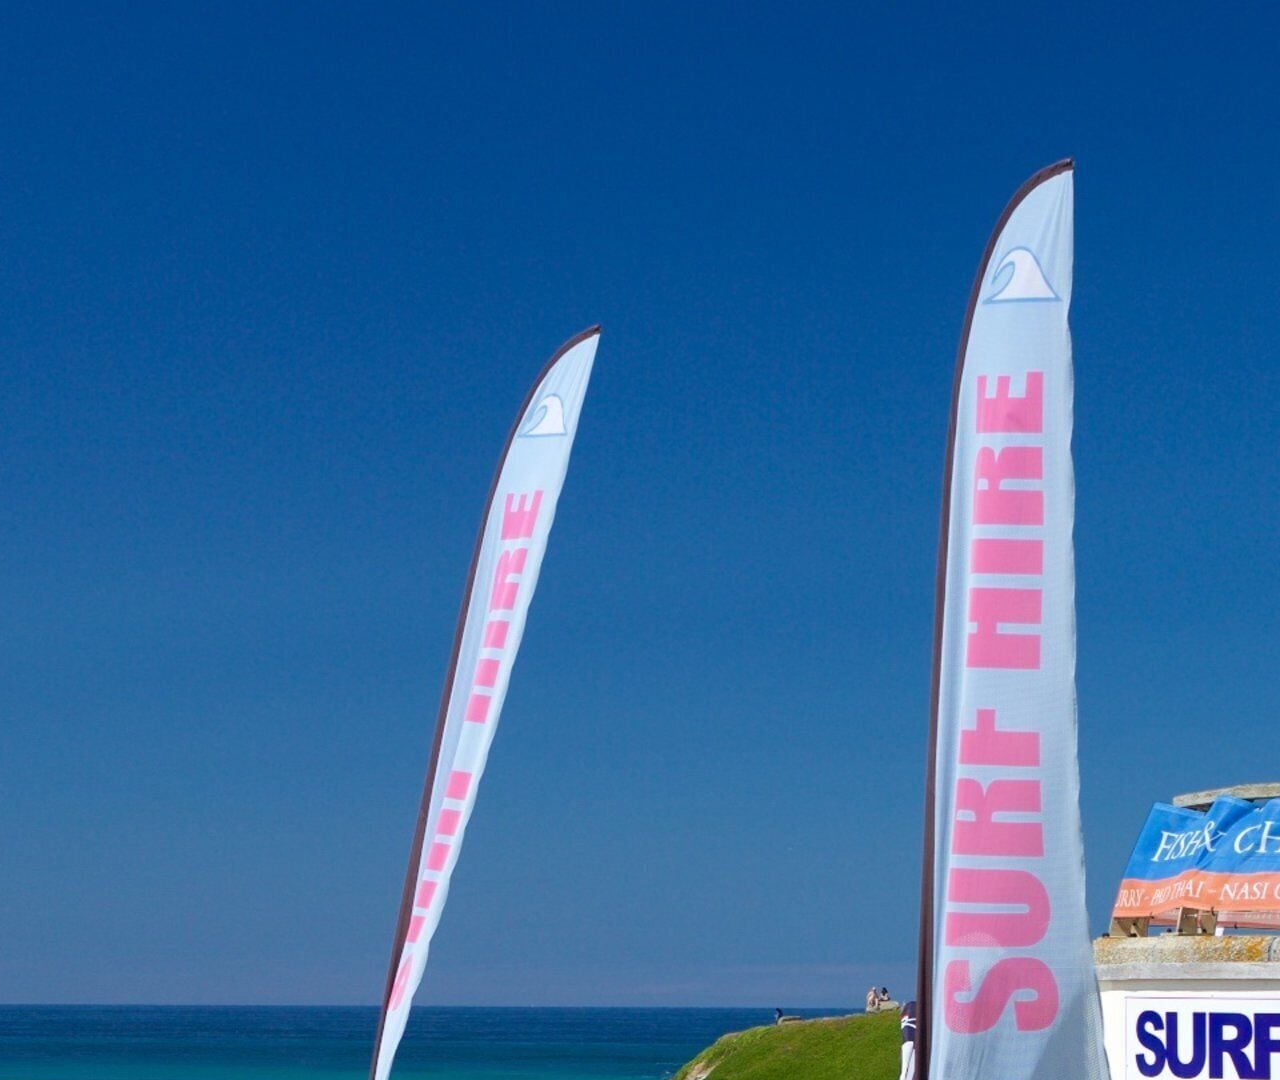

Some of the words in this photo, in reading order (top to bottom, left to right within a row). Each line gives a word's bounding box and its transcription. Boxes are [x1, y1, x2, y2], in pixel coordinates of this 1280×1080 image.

[965, 371, 1044, 670] HIRE
[944, 708, 1060, 1034] SURF
[1220, 883, 1270, 901] NASI
